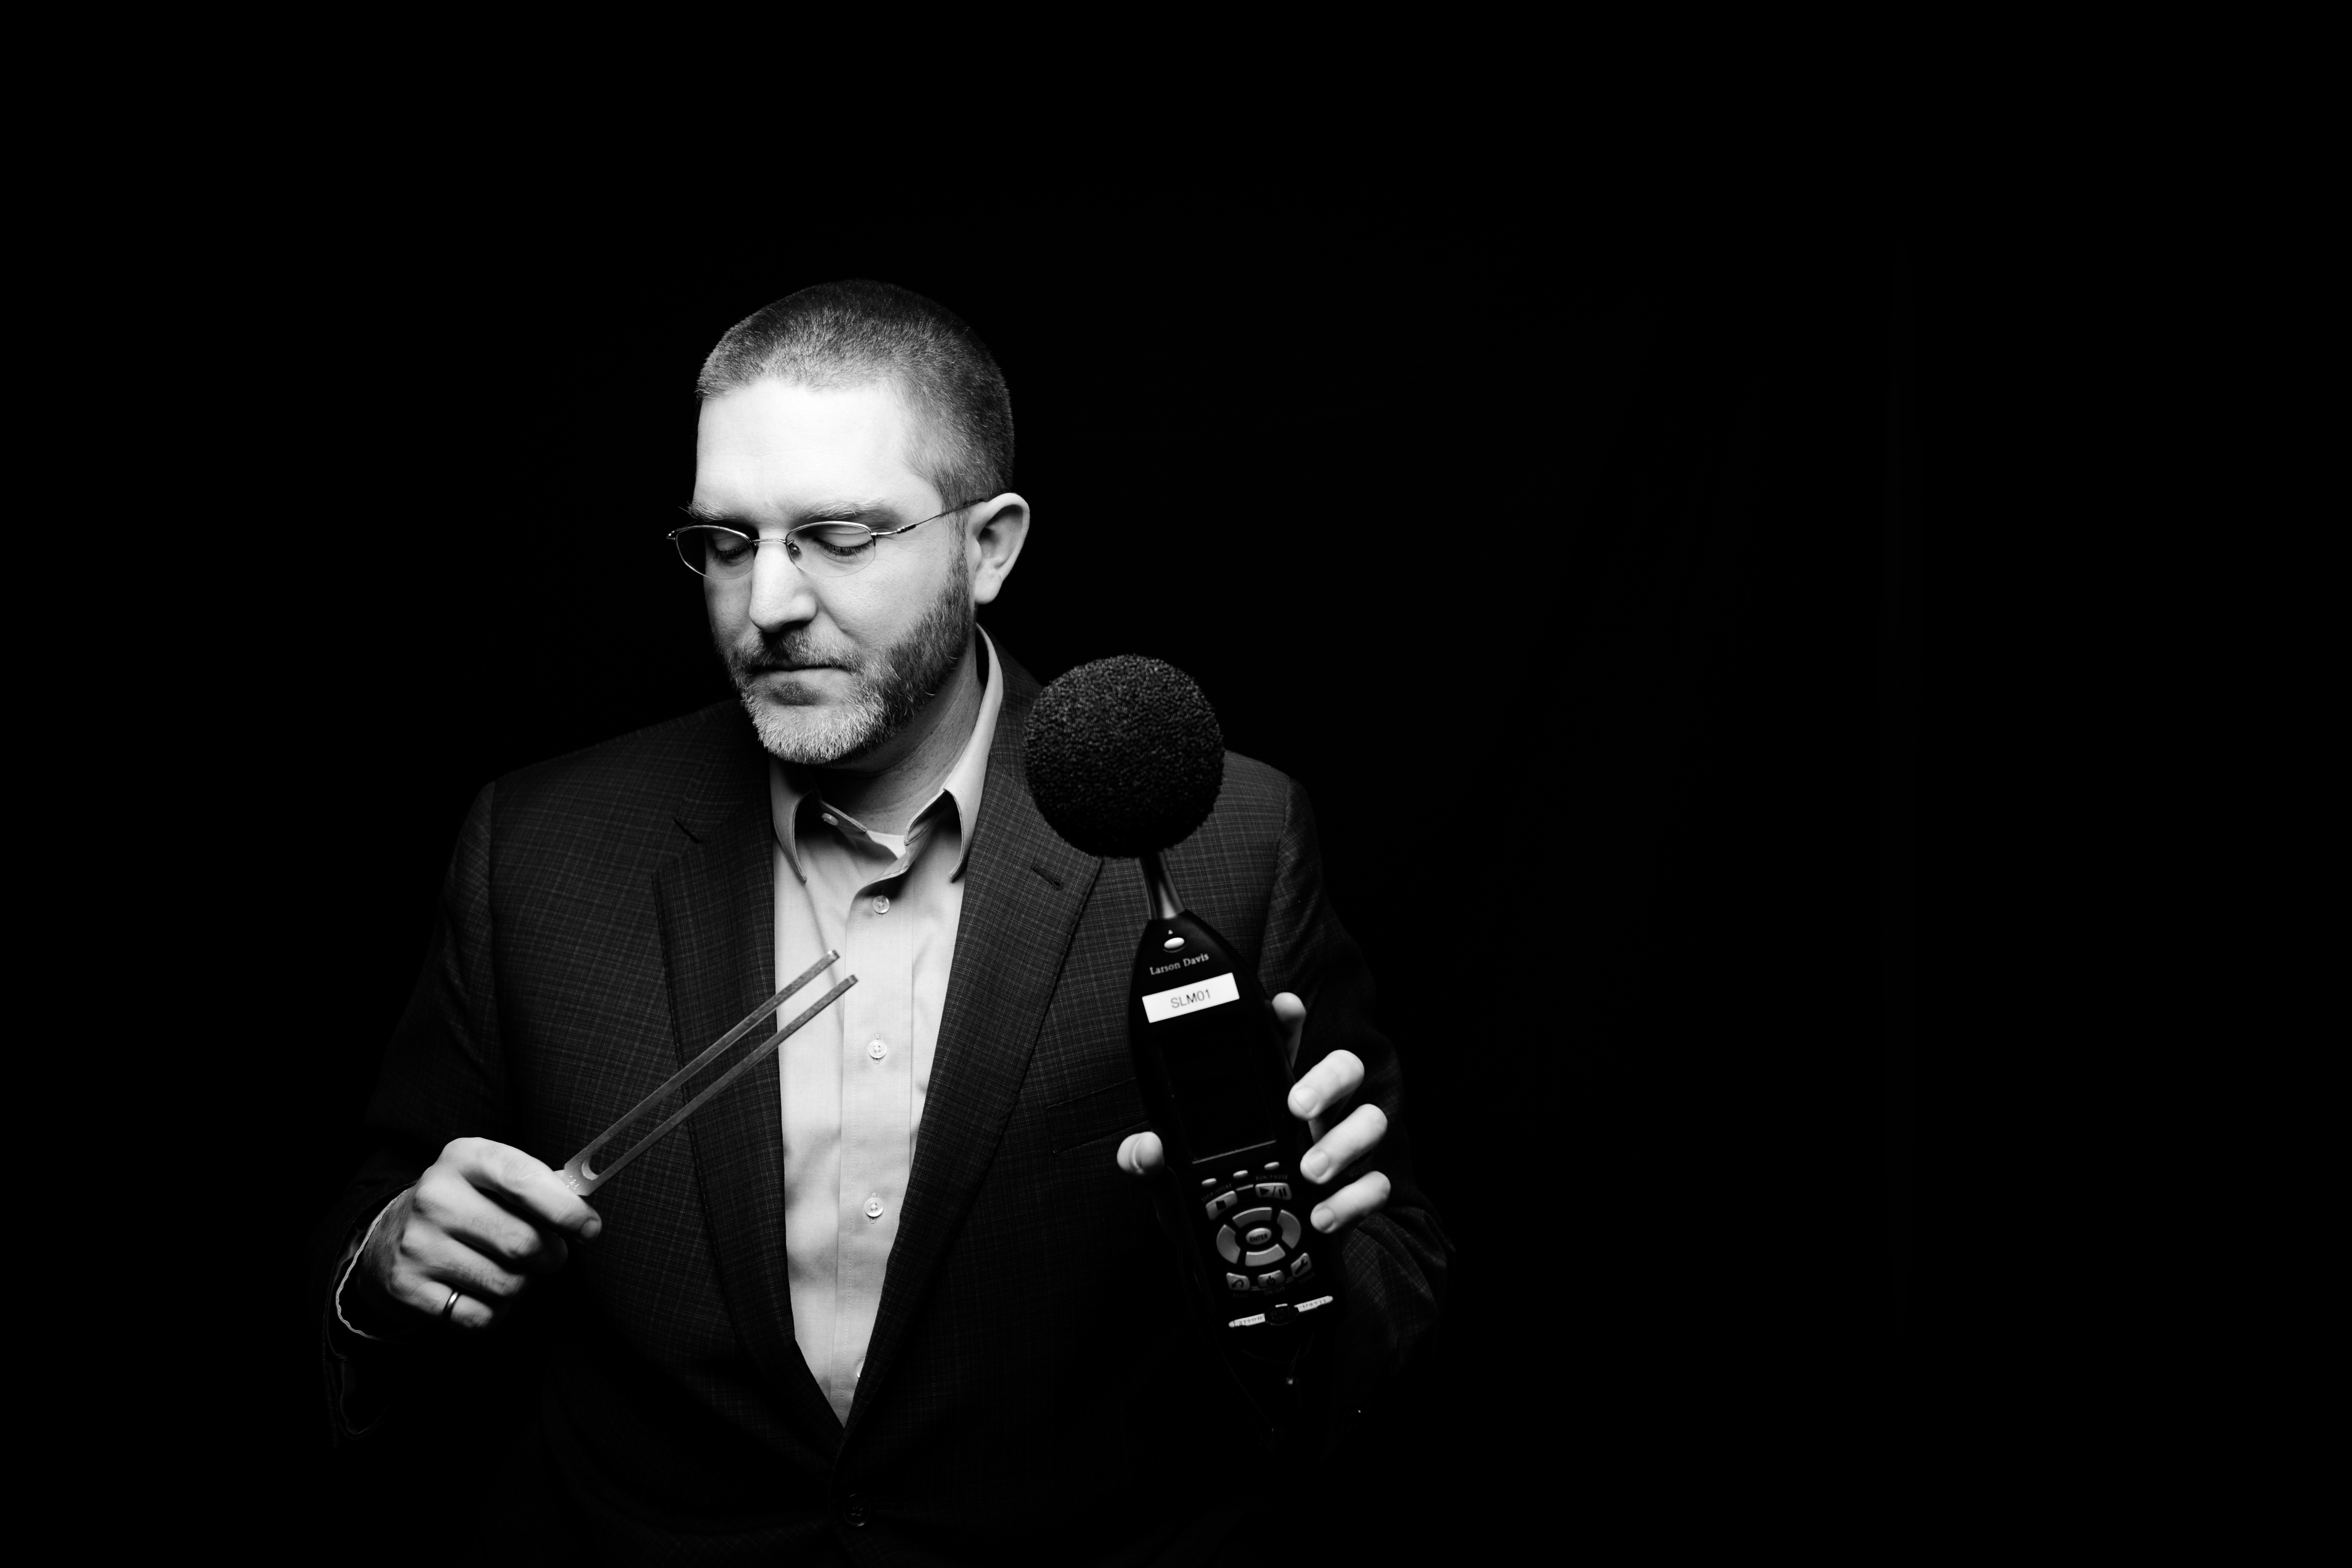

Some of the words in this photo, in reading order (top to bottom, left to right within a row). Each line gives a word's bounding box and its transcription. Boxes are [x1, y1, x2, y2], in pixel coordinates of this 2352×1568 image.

[1149, 962, 1181, 975] Larson
[1183, 953, 1210, 966] Davis
[1170, 989, 1211, 1008] SLM01
[1250, 1233, 1268, 1242] ENTER
[1263, 1287, 1285, 1296] ON/OFF
